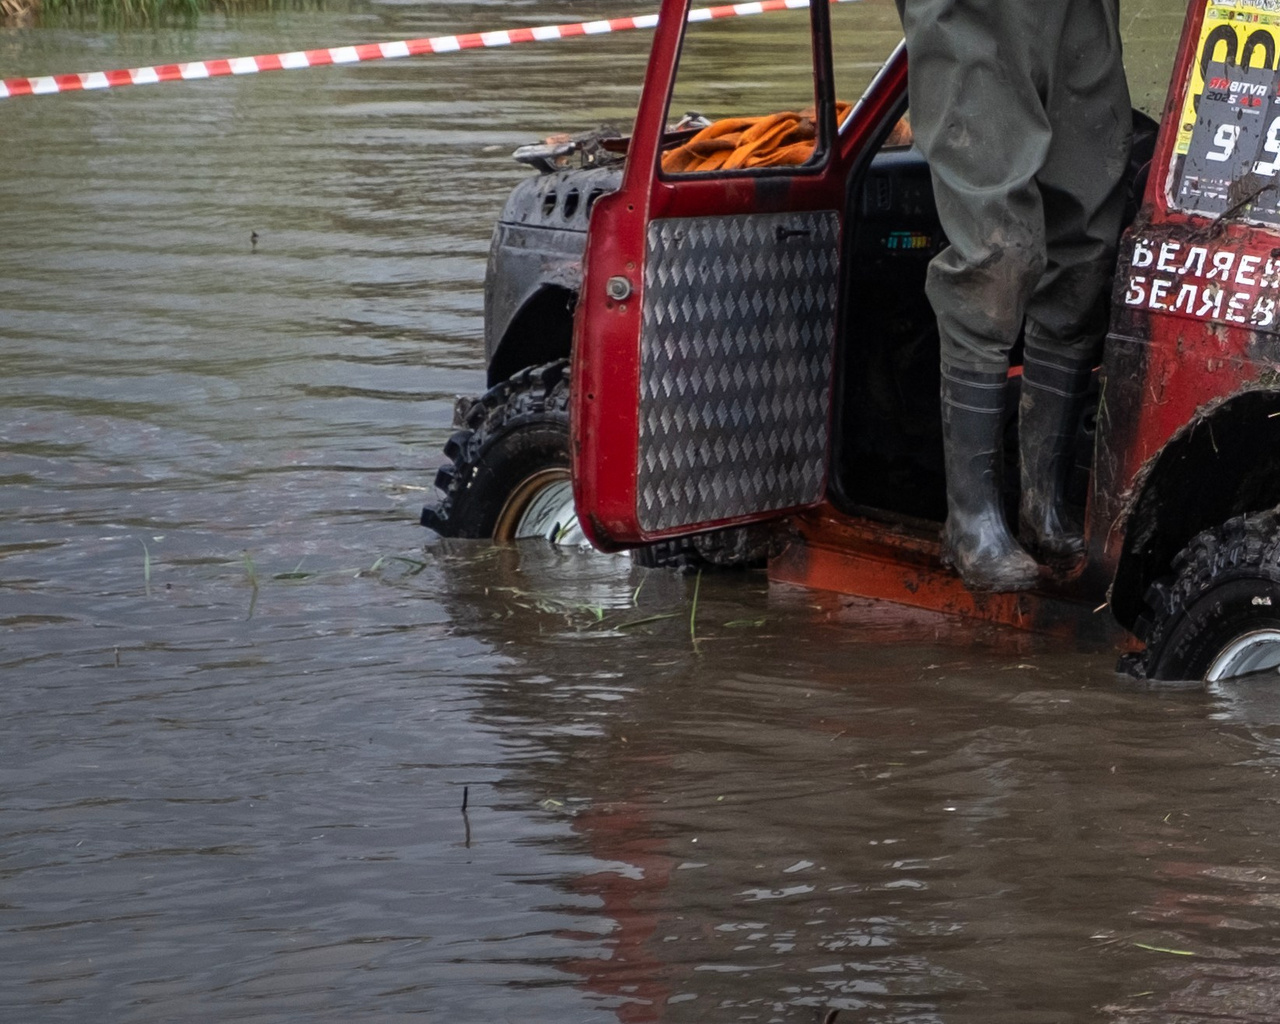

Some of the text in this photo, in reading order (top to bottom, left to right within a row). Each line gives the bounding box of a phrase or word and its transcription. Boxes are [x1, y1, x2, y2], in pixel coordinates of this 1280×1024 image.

[1205, 91, 1239, 105] 2025
[1229, 81, 1268, 97] BITVA
[1205, 124, 1241, 163] 9
[1125, 276, 1274, 326] БЕЛЯЕВ
